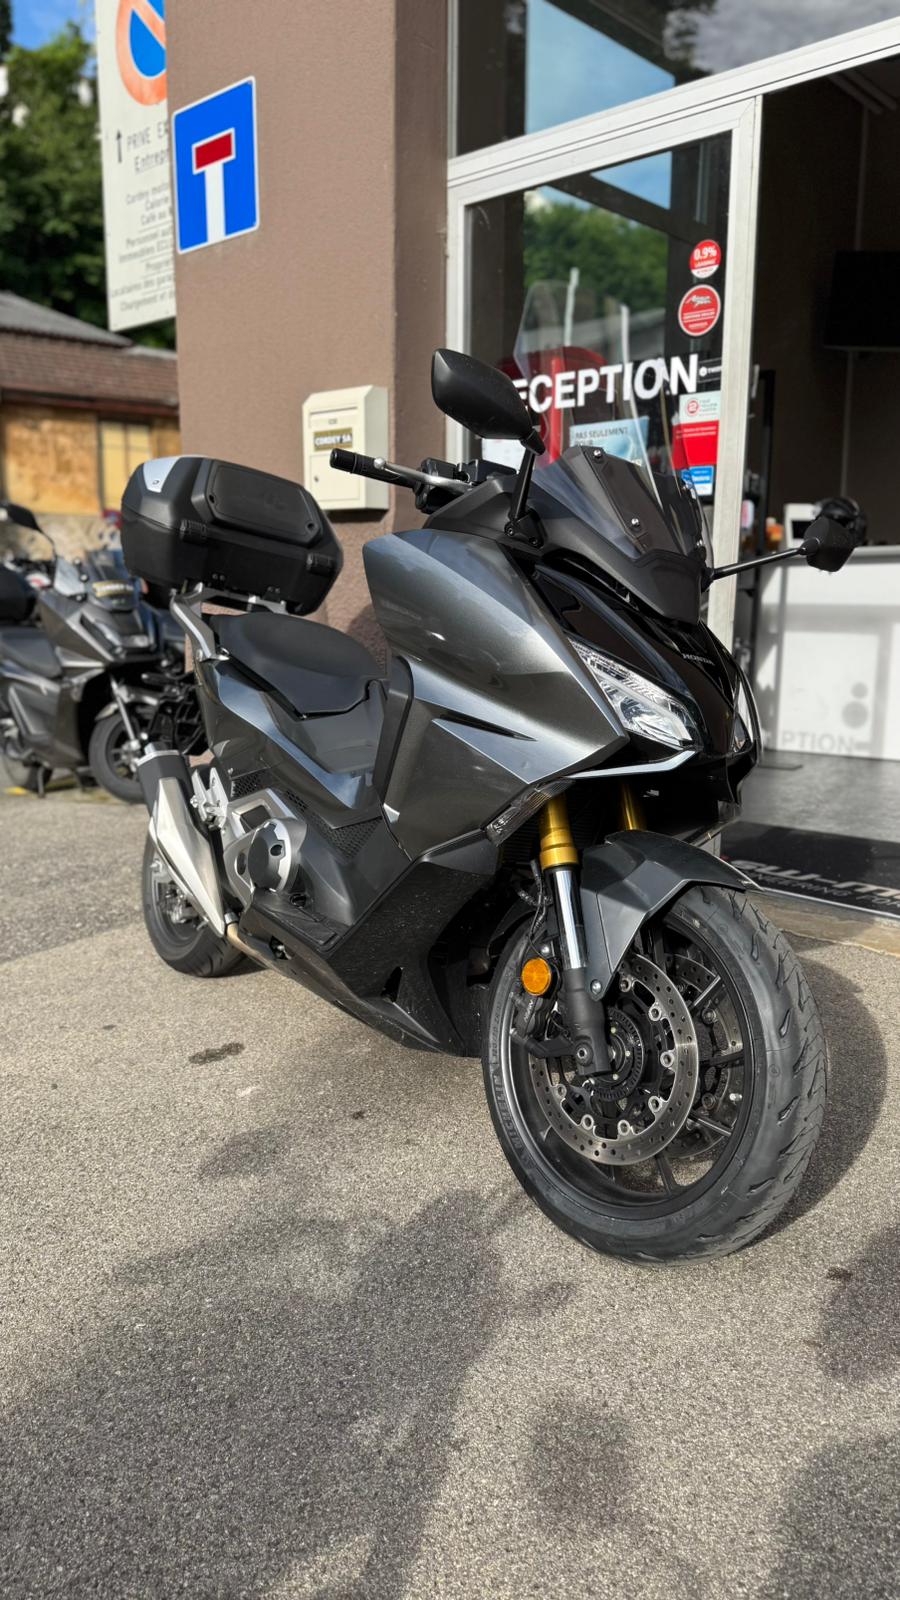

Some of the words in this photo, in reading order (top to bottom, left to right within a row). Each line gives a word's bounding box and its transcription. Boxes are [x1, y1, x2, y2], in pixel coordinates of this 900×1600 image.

[694, 245, 717, 260] 0.9%
[512, 354, 698, 414] CEPTION
[588, 426, 629, 438] SEULEMENT
[731, 860, 900, 900] SW-M
[494, 1074, 522, 1150] MICHELIN
